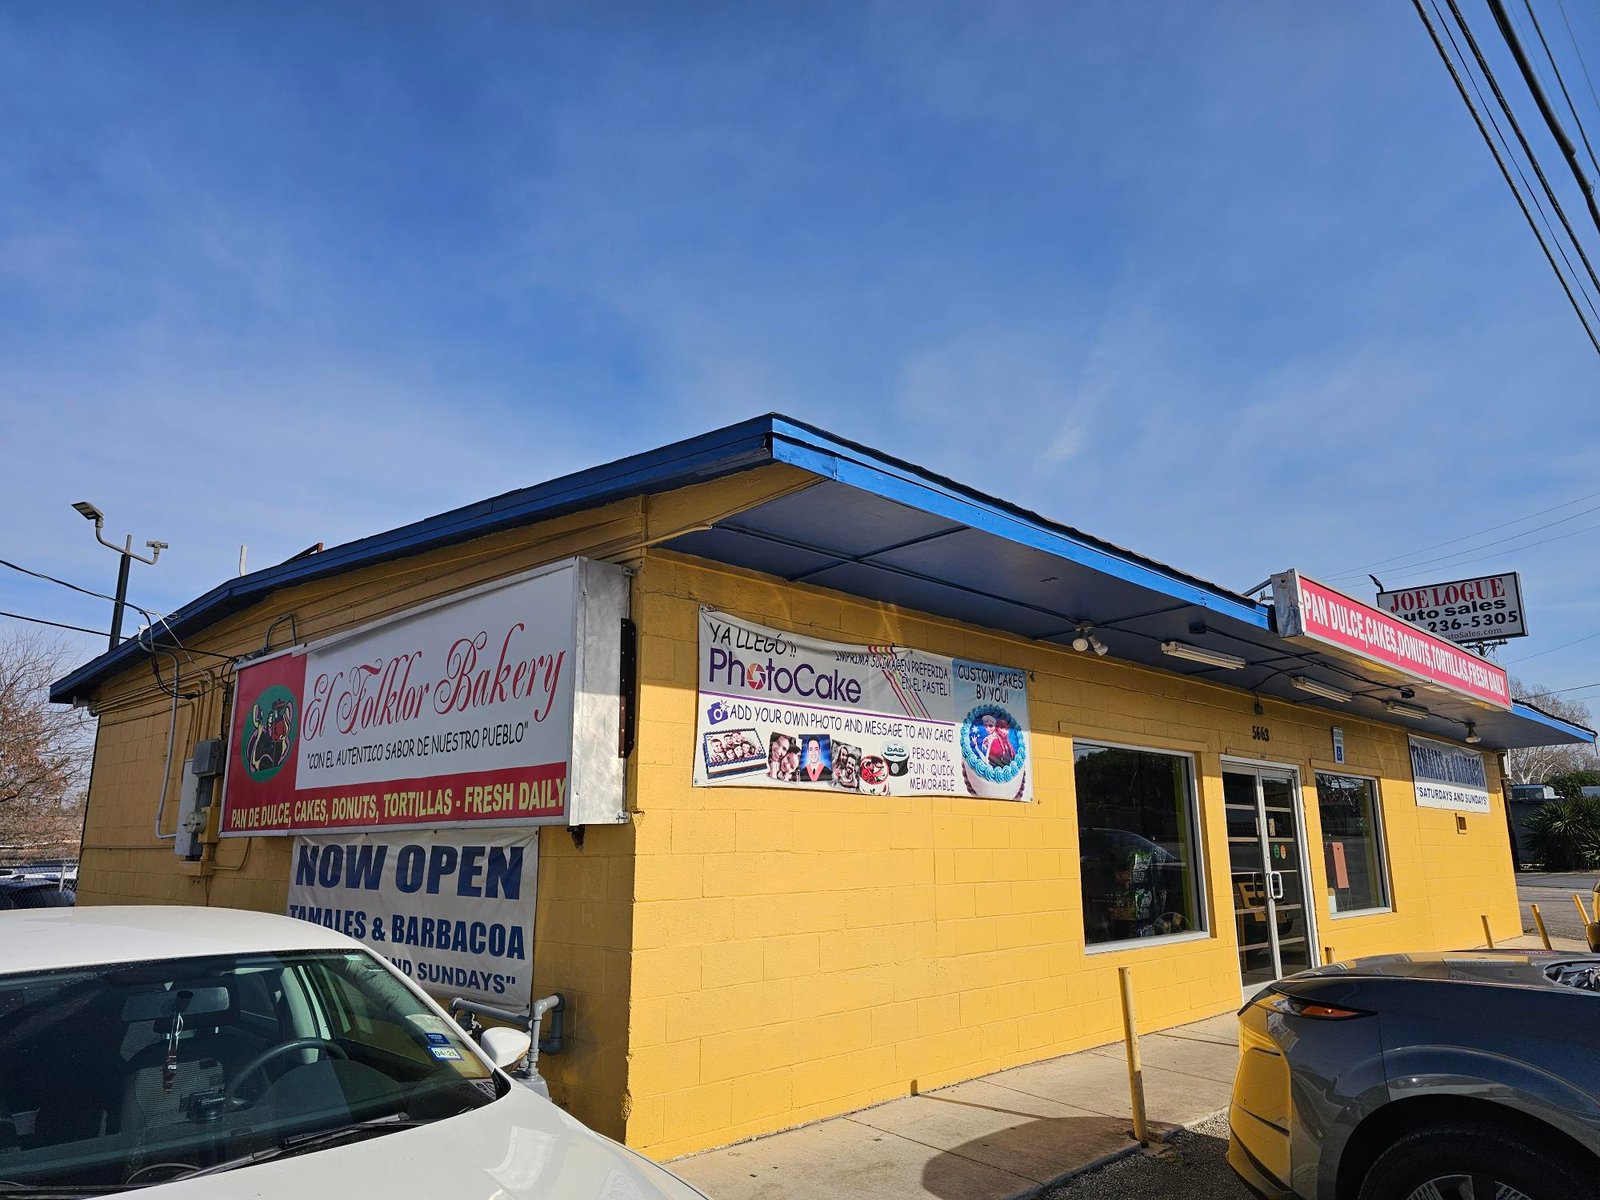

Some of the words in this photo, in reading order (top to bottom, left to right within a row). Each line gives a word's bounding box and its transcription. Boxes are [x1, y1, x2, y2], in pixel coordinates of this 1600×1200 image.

[1390, 589, 1429, 613] JOE
[1431, 577, 1506, 607] LOGUE
[1444, 599, 1507, 617] sales
[709, 622, 731, 646] YA
[1427, 610, 1519, 633] 236-5305
[1440, 628, 1503, 640] utoSales.com
[1302, 588, 1329, 627] PAN
[1467, 661, 1489, 691] FRESH
[1488, 670, 1505, 696] DAILY
[303, 671, 343, 741] El
[337, 651, 430, 735] Folklor
[433, 623, 566, 722] Bakery
[709, 647, 862, 703] PhotoCake
[913, 678, 922, 692] EL
[957, 664, 995, 685] CUSTOM
[997, 672, 1024, 689] CAKES
[976, 684, 986, 700] BY
[988, 687, 1009, 704] YOU!
[729, 704, 752, 721] ADD
[754, 707, 782, 724] YOUR
[784, 710, 809, 727] OWN
[810, 713, 842, 731] PHOTO
[844, 718, 863, 734] AND
[864, 720, 902, 738] MESSAGE
[904, 724, 916, 739] TO
[917, 725, 934, 741] ANY
[326, 751, 334, 768] EL
[336, 744, 383, 766] AUTENTICO
[385, 738, 415, 760] SABOR
[417, 736, 429, 756] DE
[432, 729, 480, 754] NUESTRO
[482, 721, 528, 747] PUEBLO"
[912, 746, 950, 762] PERSONAL
[909, 762, 925, 775] FUN
[930, 764, 955, 778] QUICK
[909, 777, 955, 792] MEMORABLE
[1453, 792, 1464, 802] AND
[231, 808, 247, 828] PAN
[248, 807, 259, 827] DE
[261, 802, 291, 828] DULCE,
[294, 799, 328, 825] CAKES,
[332, 795, 379, 824] DONUTS,
[384, 788, 452, 818] TORTILLAS
[464, 783, 514, 813] FRESH
[518, 777, 566, 810] DAILY
[295, 844, 388, 890] NOW
[395, 844, 524, 900] OPEN
[371, 917, 386, 942] &
[391, 914, 525, 960] BARBACOA
[384, 956, 412, 977] ND
[417, 962, 516, 994] SUNDAYS"
